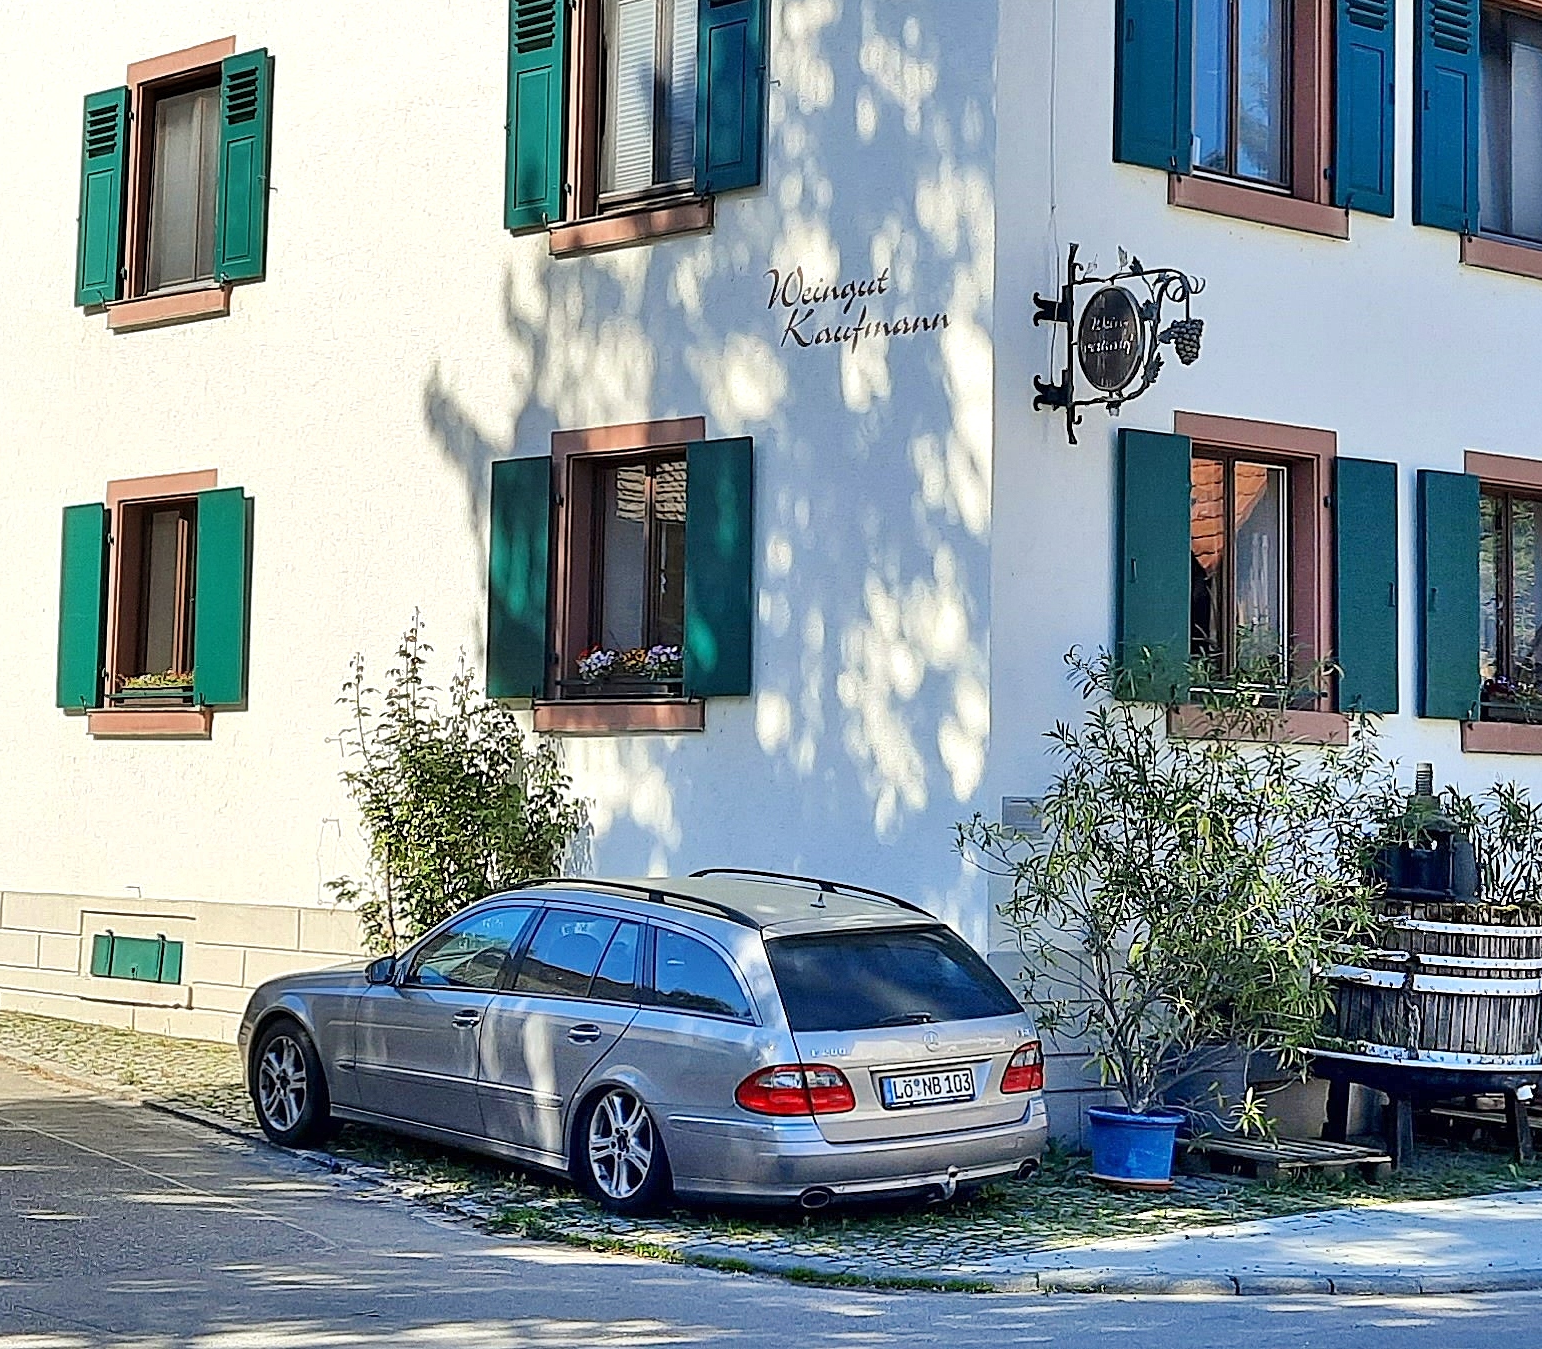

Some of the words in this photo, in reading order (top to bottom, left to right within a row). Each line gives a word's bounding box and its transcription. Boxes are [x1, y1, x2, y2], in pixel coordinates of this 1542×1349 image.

[763, 265, 889, 314] Weingut
[780, 305, 951, 353] Kaufmann
[923, 1076, 942, 1096] NB
[944, 1073, 971, 1094] 103
